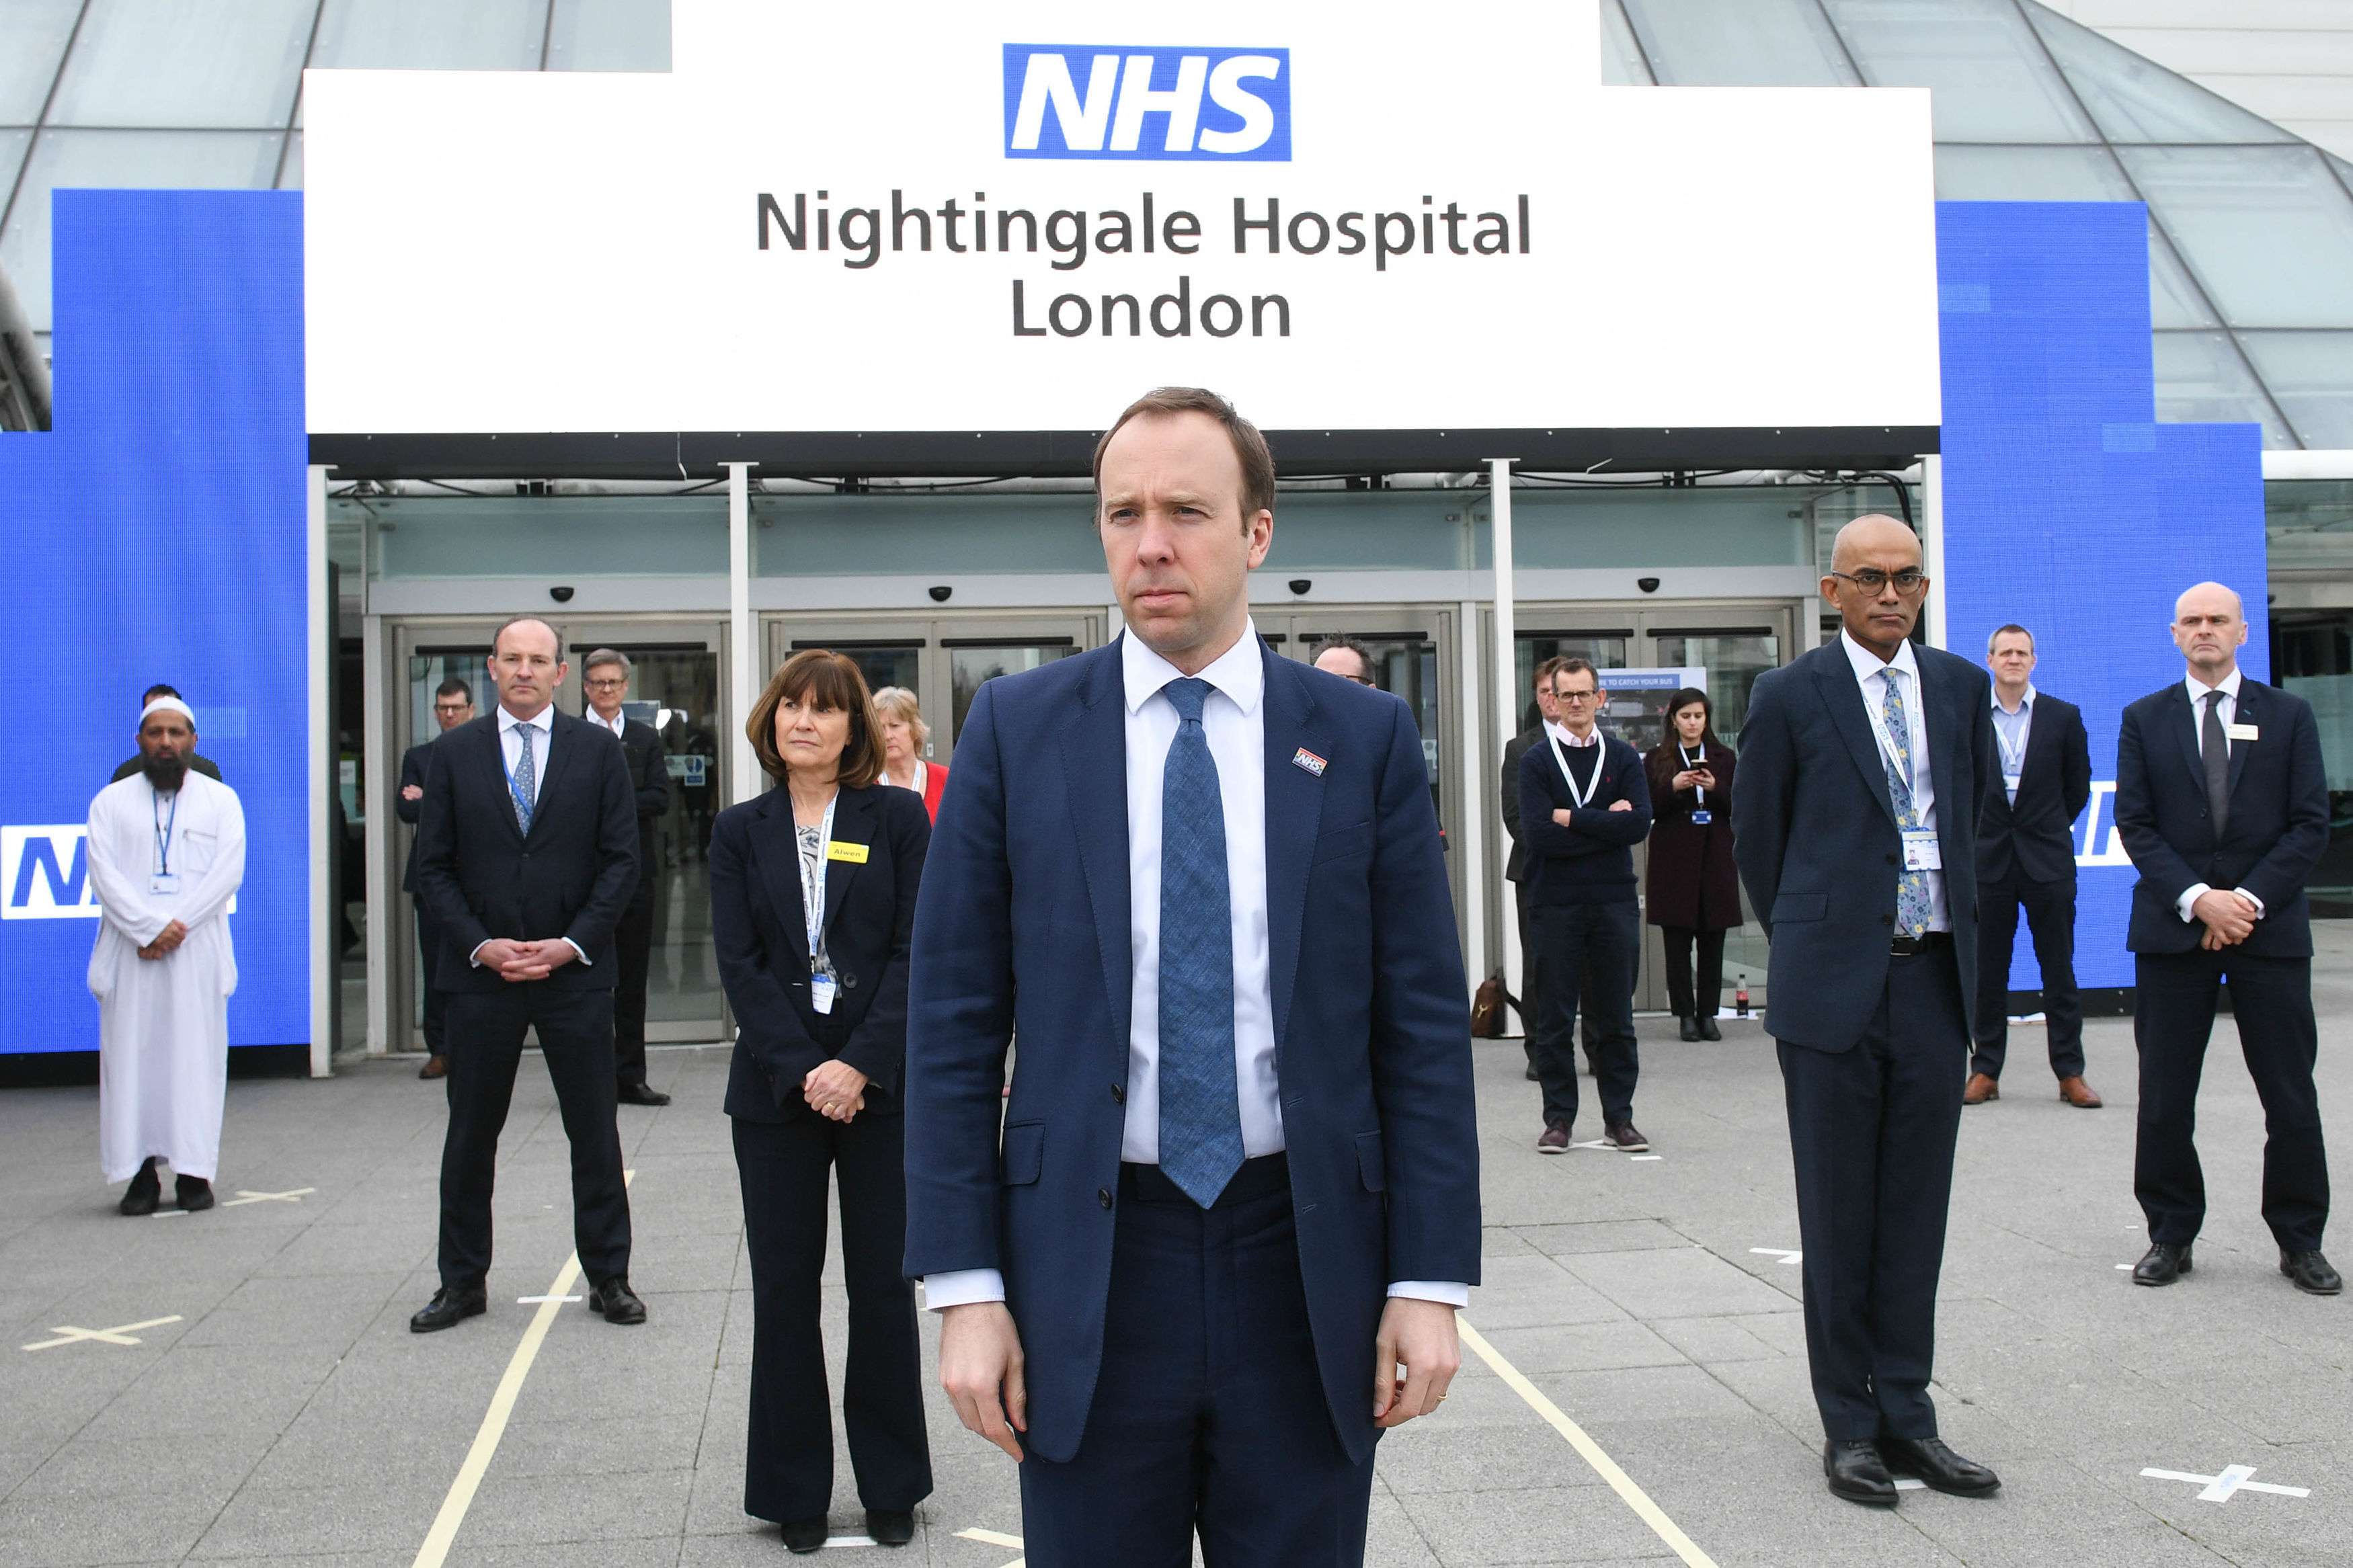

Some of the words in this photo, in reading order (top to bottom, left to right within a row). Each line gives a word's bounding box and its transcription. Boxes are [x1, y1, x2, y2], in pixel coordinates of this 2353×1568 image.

[1012, 54, 1279, 153] NHS
[758, 190, 1201, 270] Nightingale
[1234, 195, 1529, 271] Hospital
[1013, 276, 1289, 337] London
[1298, 753, 1322, 771] NHS
[834, 849, 861, 857] Alwen
